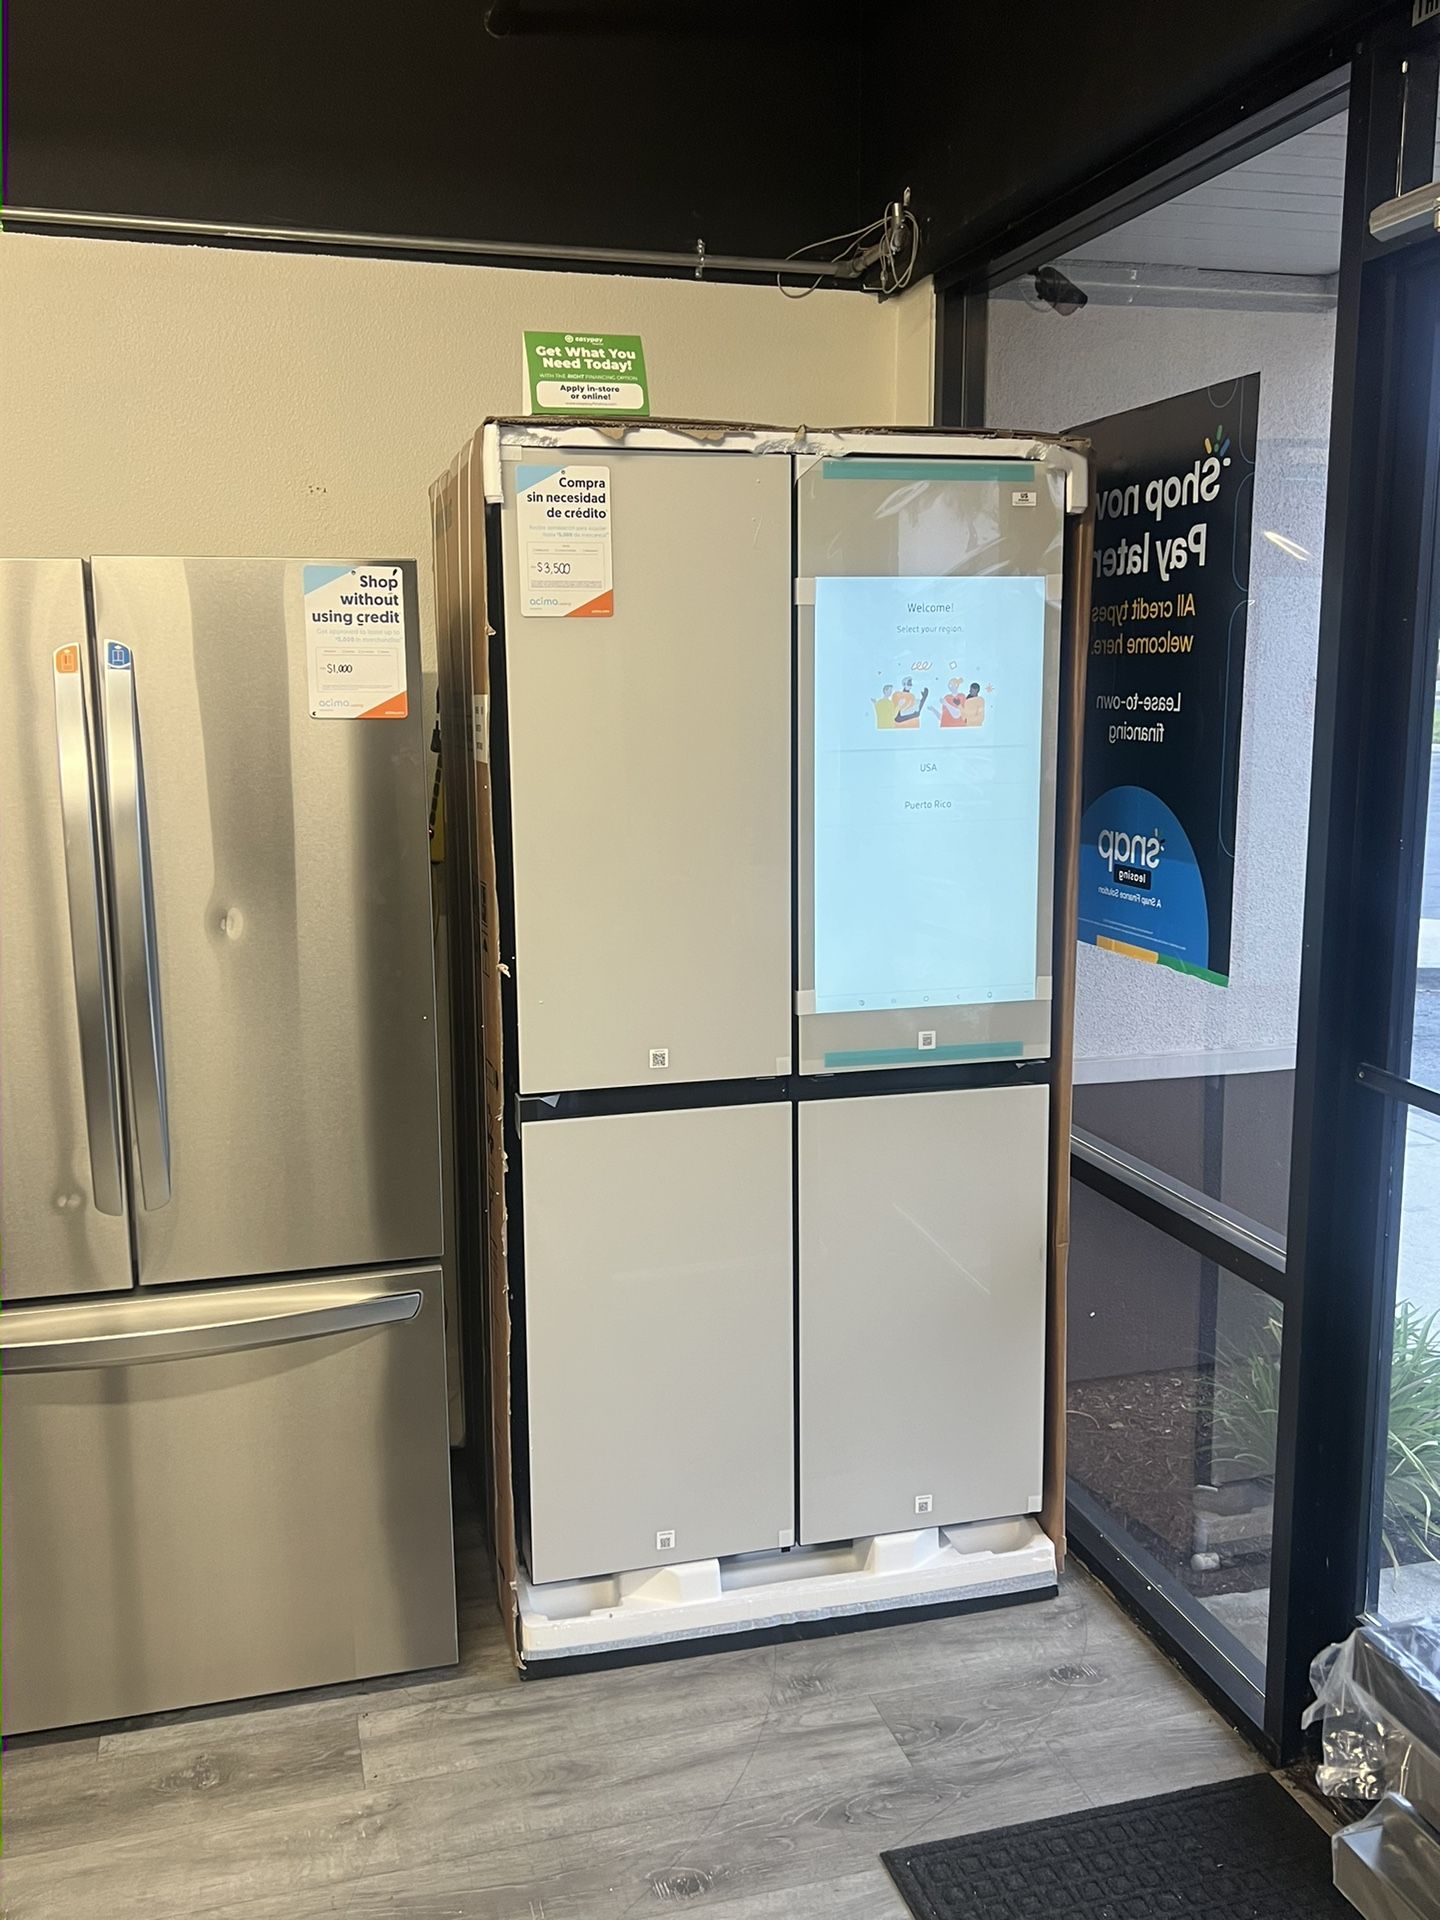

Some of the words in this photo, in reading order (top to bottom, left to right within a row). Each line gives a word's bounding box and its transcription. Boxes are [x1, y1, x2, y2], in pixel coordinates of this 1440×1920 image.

[536, 346, 562, 356] Get
[565, 347, 605, 358] What
[608, 349, 636, 359] You
[543, 358, 581, 369] Need
[584, 359, 632, 372] Today!
[560, 384, 585, 393] Apply
[559, 478, 605, 490] Compra
[527, 492, 543, 502] sin
[546, 493, 605, 503] necesidad
[547, 507, 562, 517] de
[564, 508, 606, 518] crédito
[537, 562, 570, 574] $3,500
[360, 575, 398, 591] Shop
[340, 593, 399, 606] without
[908, 603, 954, 613] Welcome!
[312, 610, 352, 625] using
[357, 611, 399, 623] credit
[921, 626, 937, 634] your
[939, 626, 964, 634] region.
[327, 664, 353, 674] $1,000
[920, 763, 937, 772] USA
[905, 801, 932, 809] Puerto
[934, 800, 951, 808] Rico
